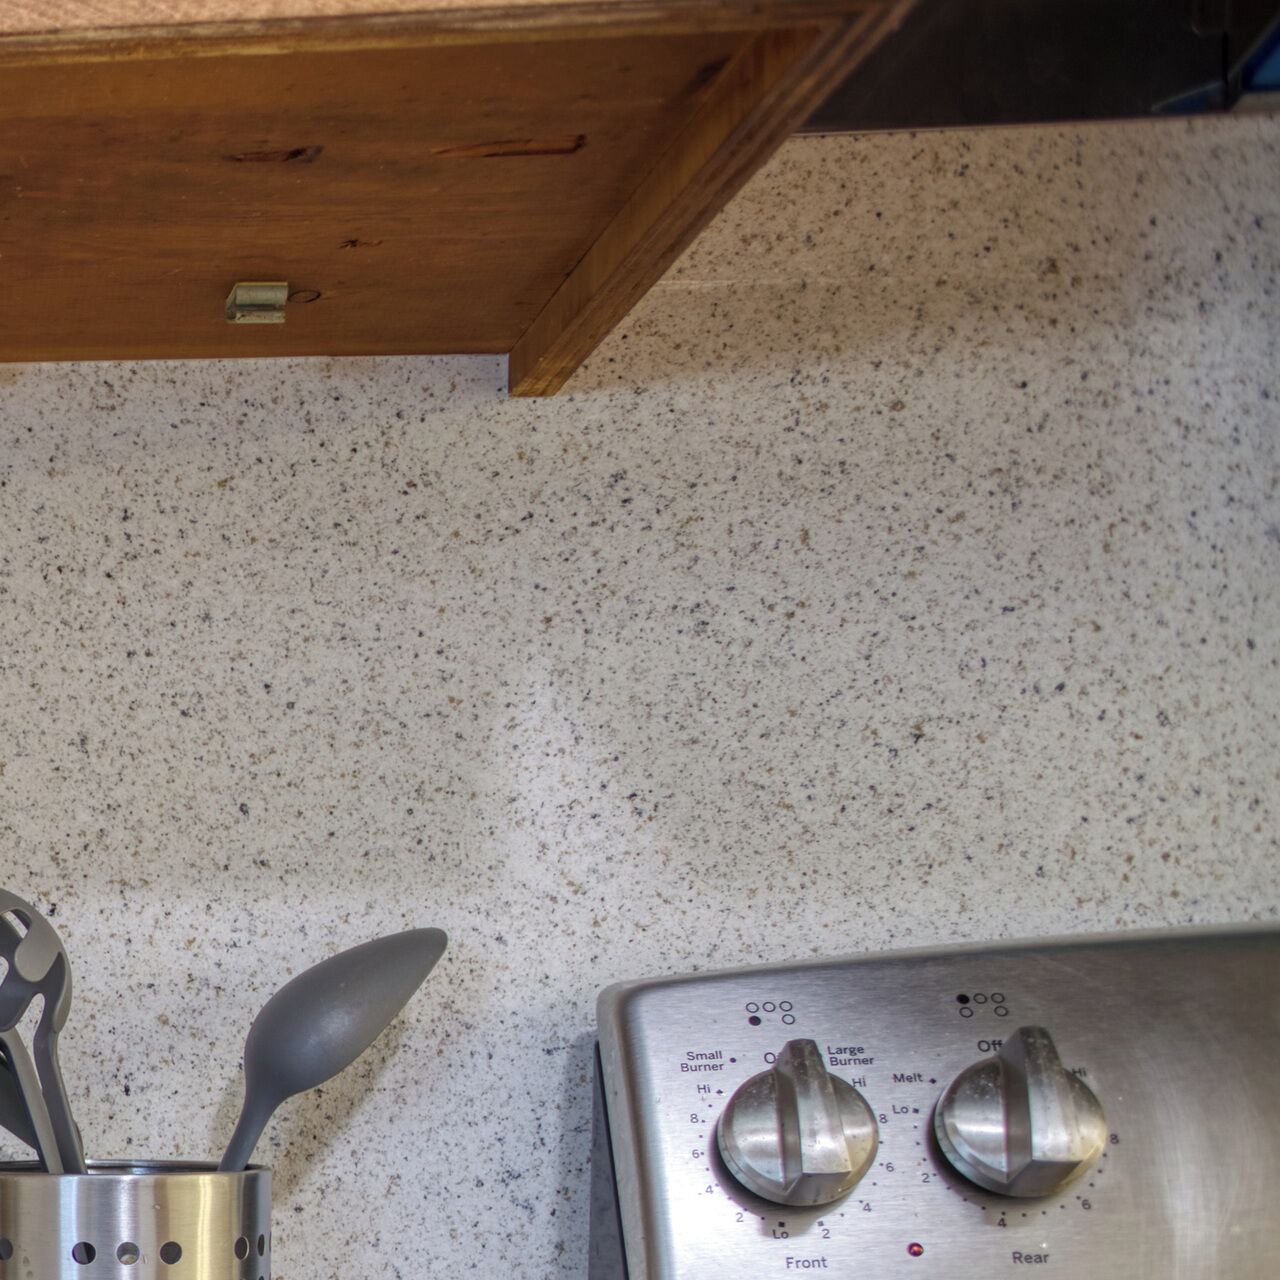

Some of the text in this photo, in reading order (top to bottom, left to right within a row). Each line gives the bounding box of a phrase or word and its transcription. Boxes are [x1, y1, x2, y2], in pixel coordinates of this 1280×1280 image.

[827, 1045, 865, 1057] Large
[977, 1039, 1003, 1053] Off
[686, 1051, 723, 1061] Small
[829, 1056, 875, 1066] Burner
[681, 1062, 725, 1073] Burner
[852, 1077, 867, 1088] Hi
[893, 1073, 924, 1083] Melt
[697, 1084, 711, 1094] Hi
[893, 1105, 909, 1115] Lo
[690, 1114, 699, 1124] 8
[879, 1114, 888, 1124] 8
[1110, 1134, 1119, 1144] 8
[691, 1149, 700, 1159] 6
[886, 1162, 894, 1172] 6
[922, 1173, 930, 1183] 2
[705, 1185, 714, 1195] 4
[863, 1203, 872, 1212] 4
[1082, 1199, 1091, 1210] 6
[735, 1213, 744, 1222] 2
[997, 1218, 1007, 1228] 4
[772, 1229, 789, 1239] Lo
[822, 1229, 831, 1239] 2
[786, 1256, 827, 1269] Front
[1012, 1252, 1049, 1264] Rear
